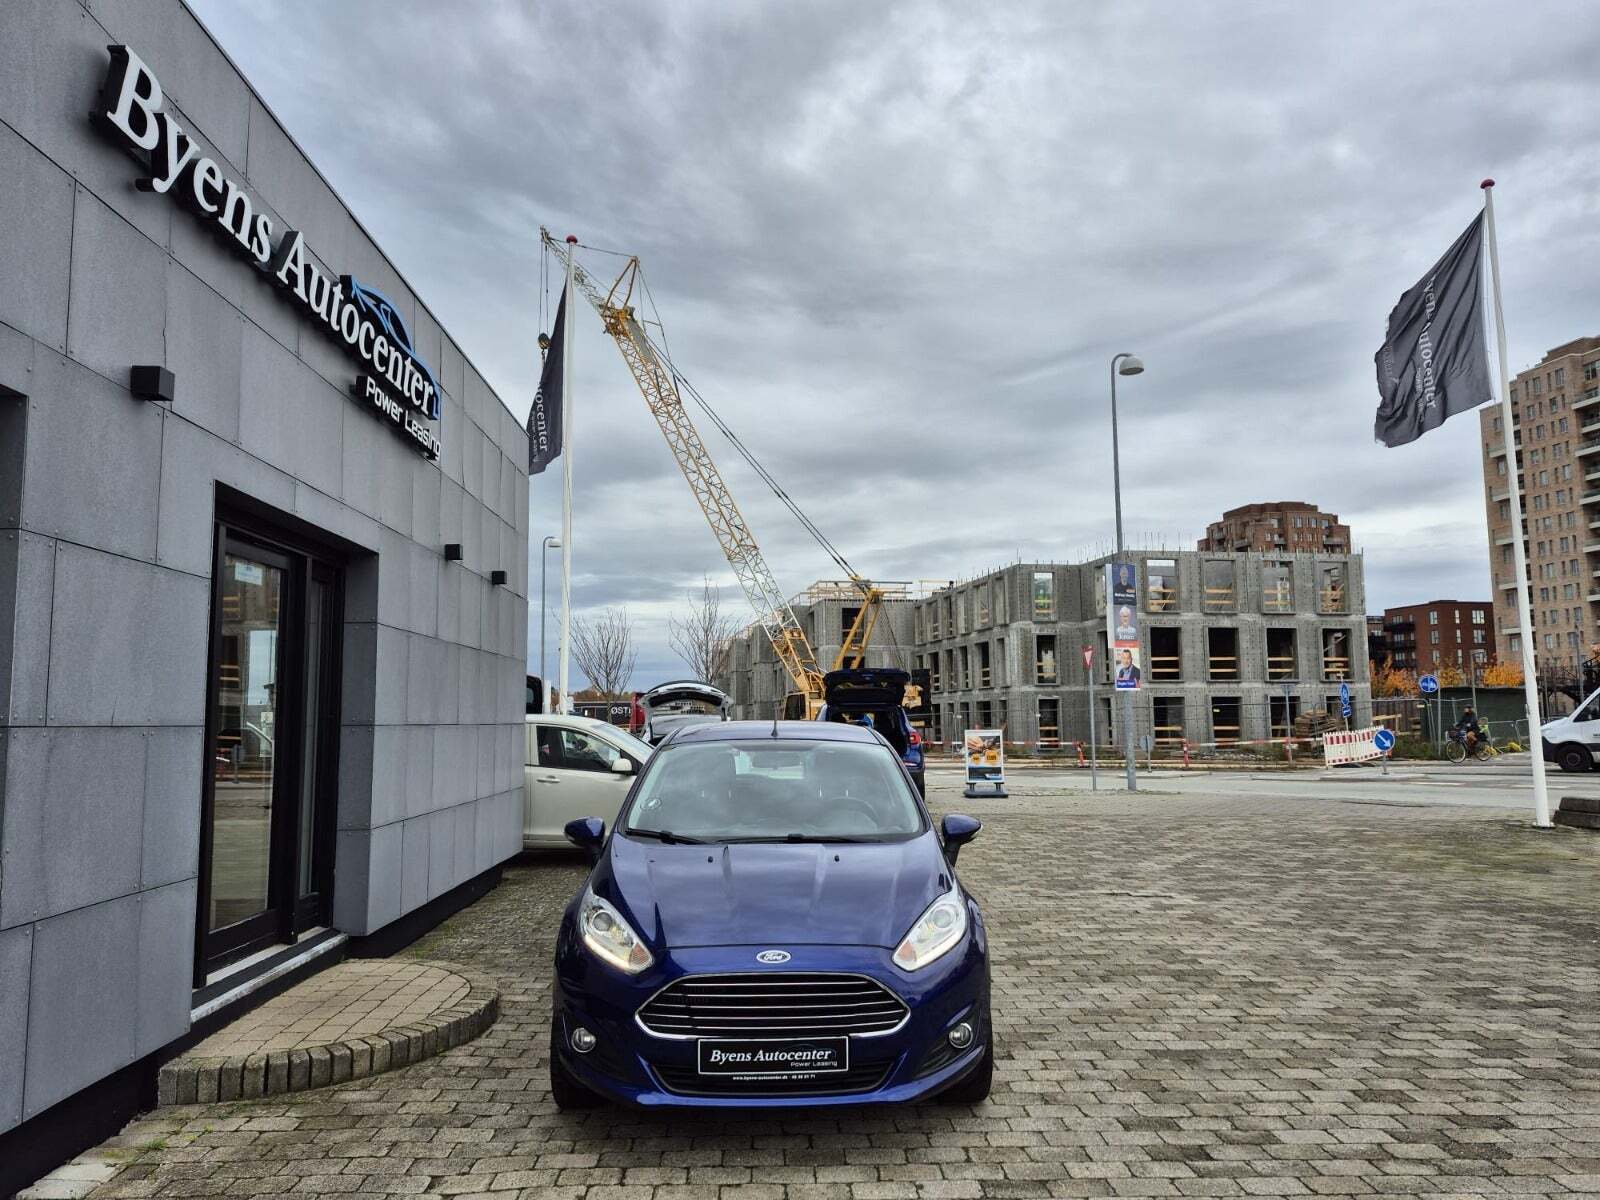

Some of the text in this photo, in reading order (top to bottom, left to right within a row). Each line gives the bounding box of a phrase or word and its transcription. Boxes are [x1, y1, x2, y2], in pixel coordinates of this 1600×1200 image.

[106, 45, 434, 415] Byens Autocenter
[366, 375, 441, 461] Power Leasing
[611, 706, 631, 715] ØST
[710, 1049, 832, 1065] Byens Autocenter
